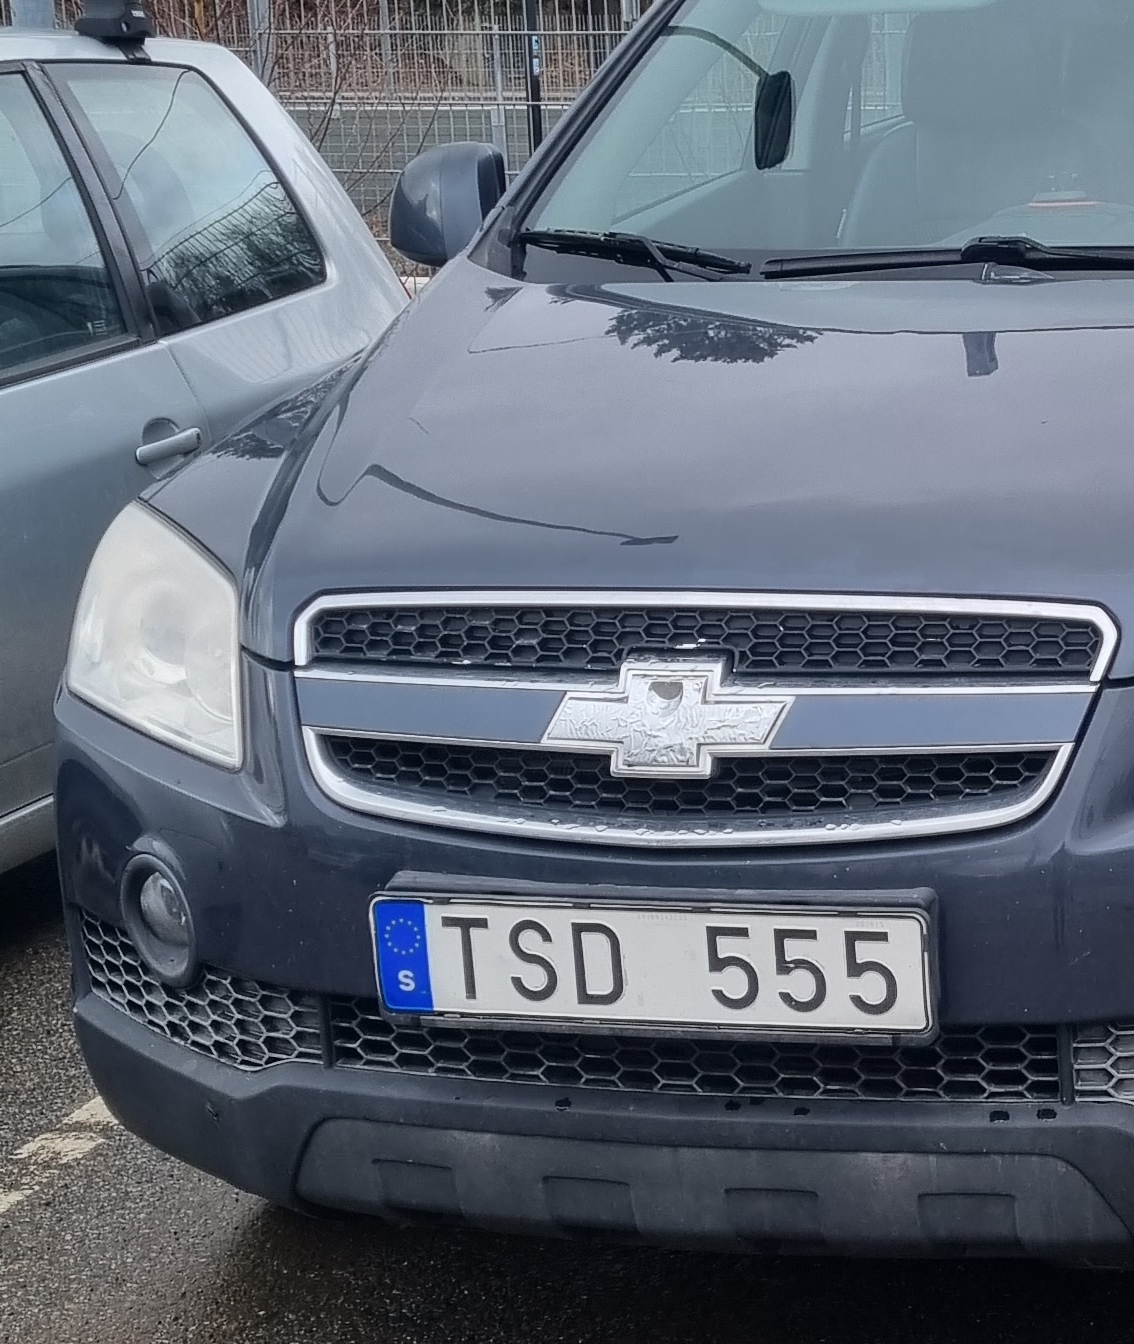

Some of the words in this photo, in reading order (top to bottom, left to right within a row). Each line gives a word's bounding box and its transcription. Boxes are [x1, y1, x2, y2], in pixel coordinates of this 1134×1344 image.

[397, 969, 416, 992] S
[441, 916, 625, 1006] TSD
[705, 925, 898, 1016] 555
